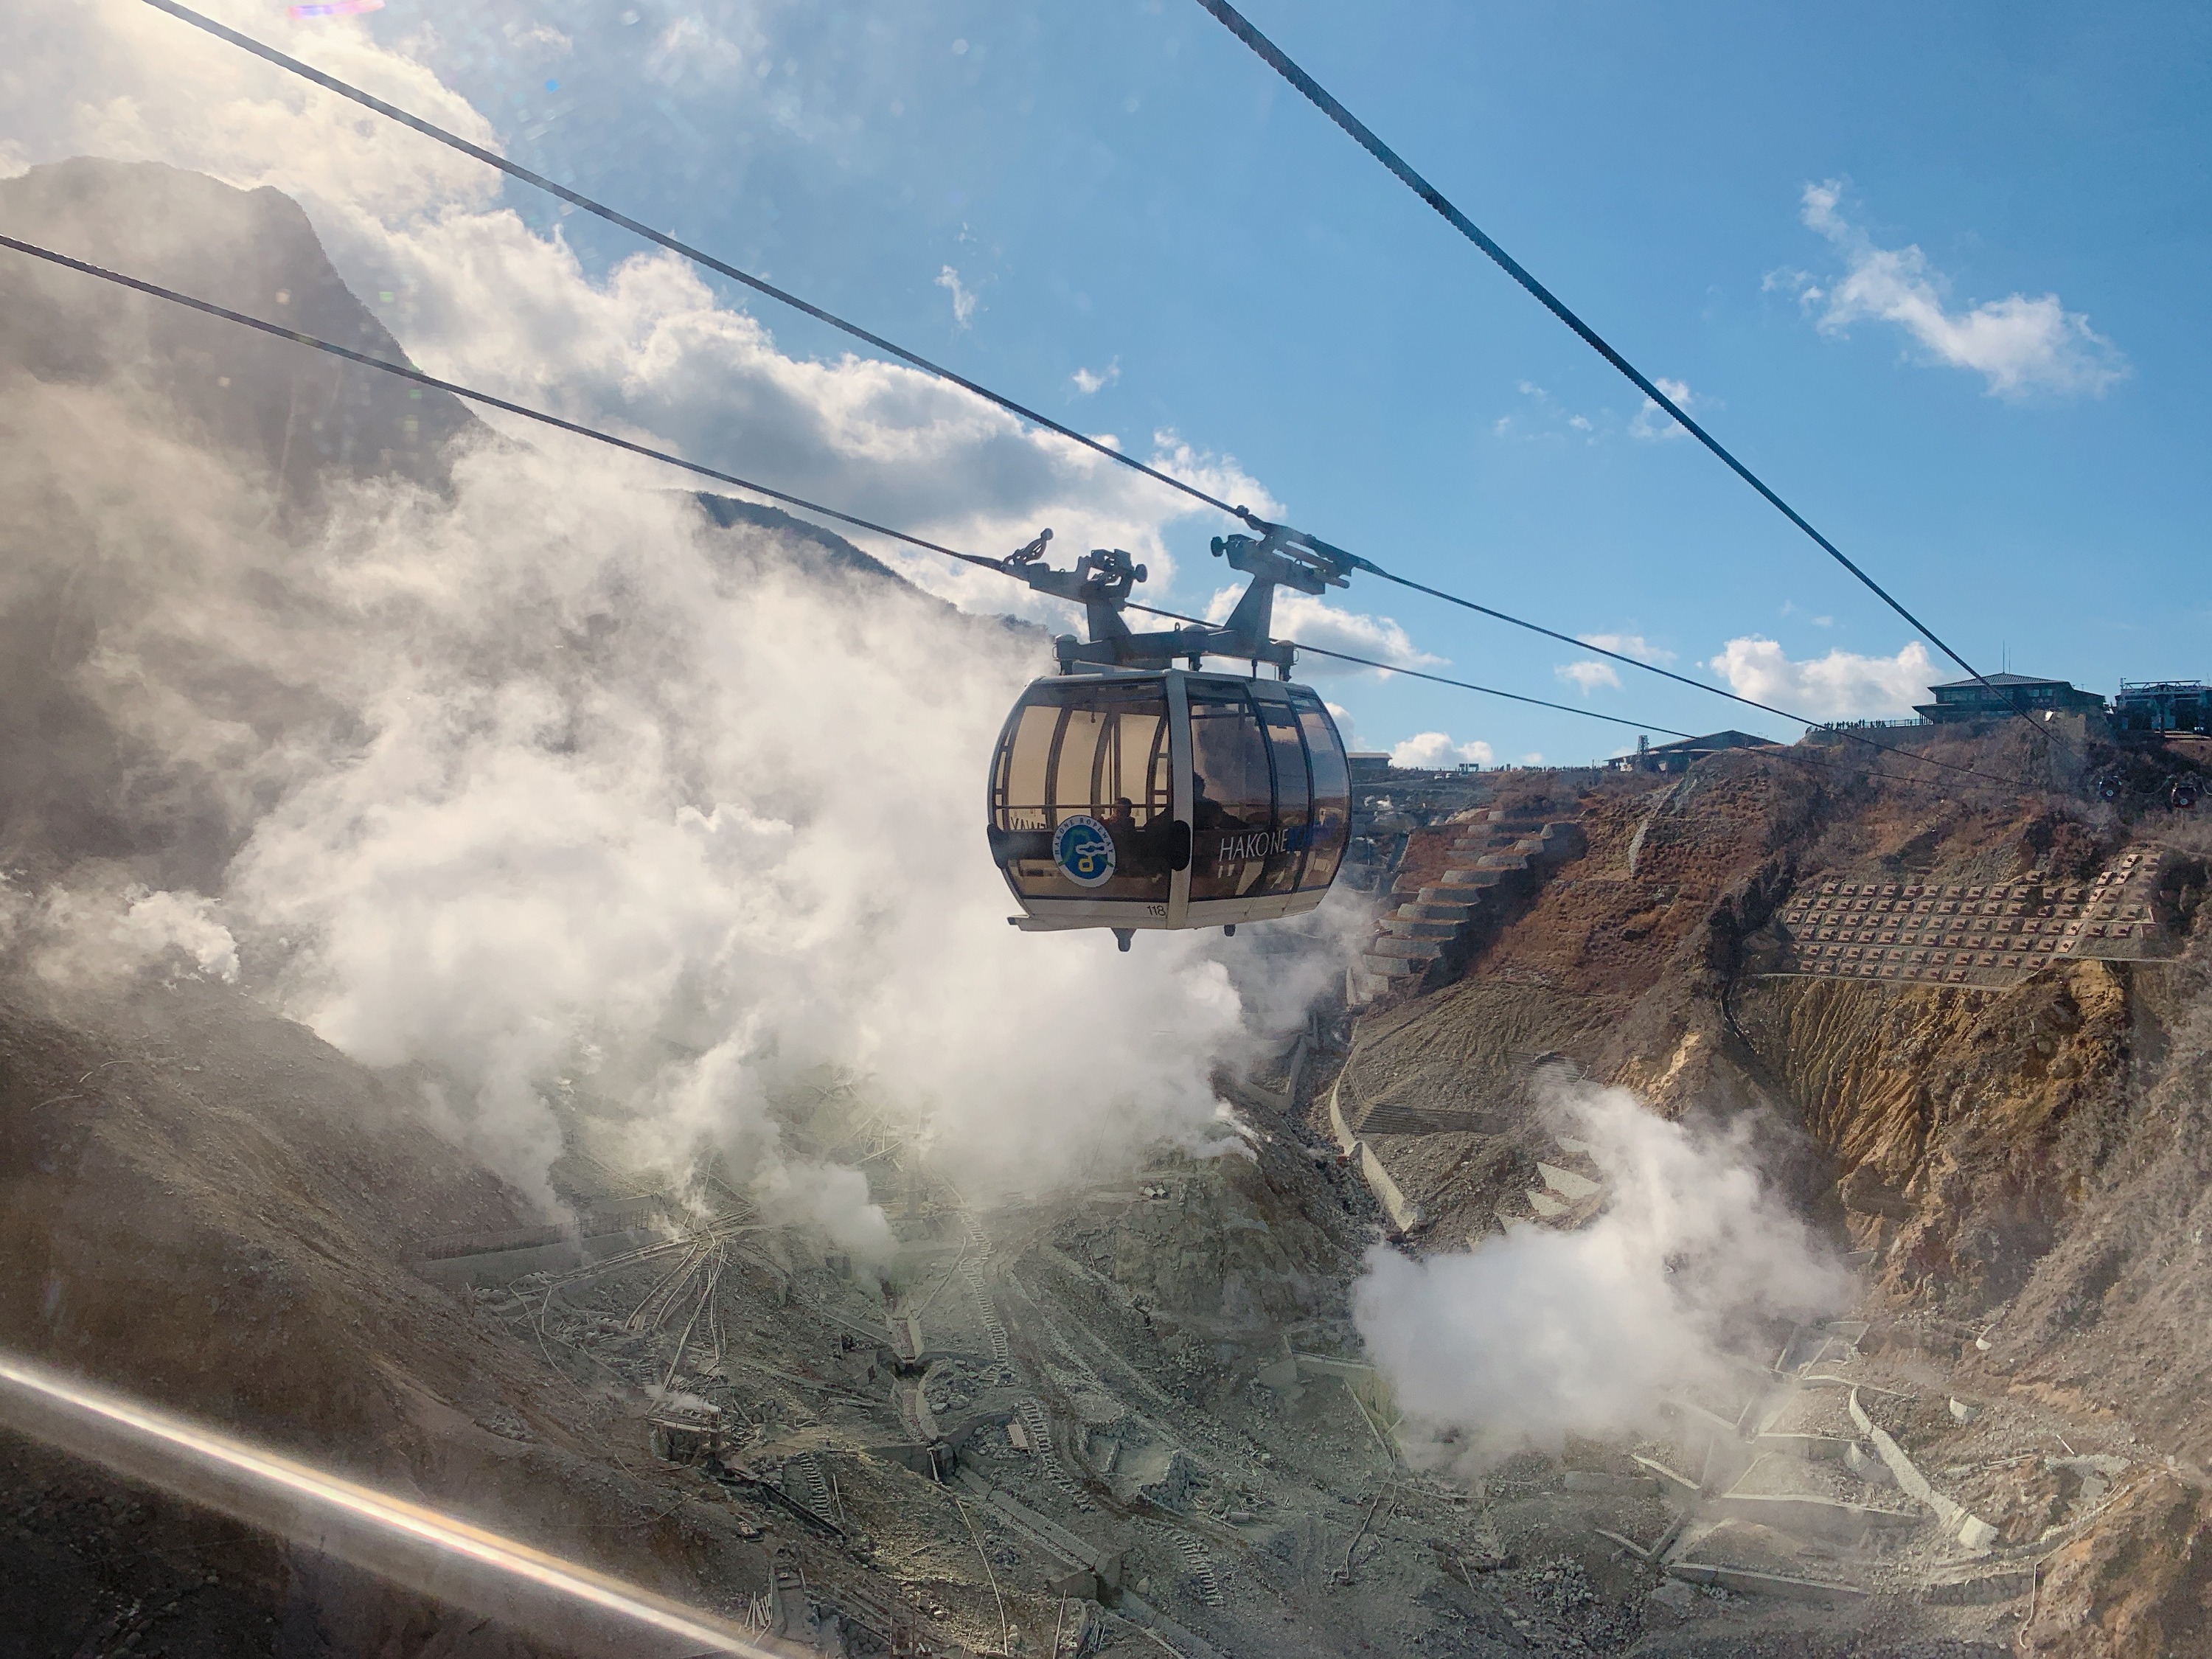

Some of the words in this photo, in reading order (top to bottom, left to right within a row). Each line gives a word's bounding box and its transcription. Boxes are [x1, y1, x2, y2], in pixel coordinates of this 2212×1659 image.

[1054, 818, 1075, 855] HAKONE
[1079, 817, 1114, 853] ROPEWAY
[1219, 828, 1289, 862] HAKONE
[1147, 905, 1166, 917] 118
